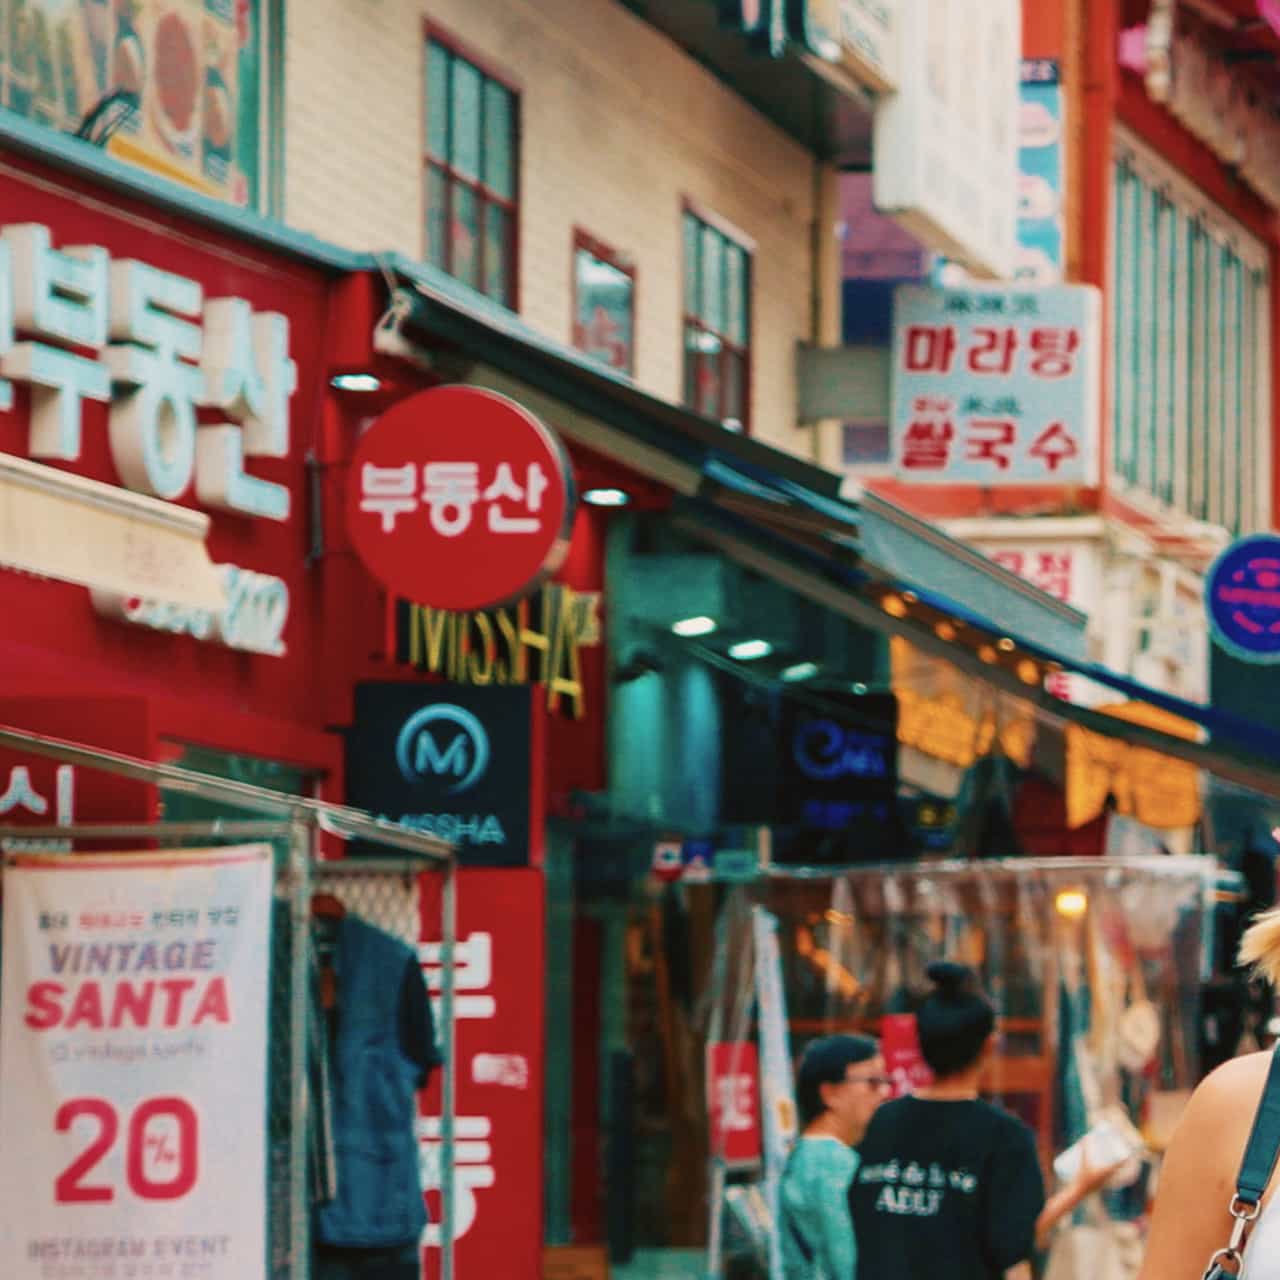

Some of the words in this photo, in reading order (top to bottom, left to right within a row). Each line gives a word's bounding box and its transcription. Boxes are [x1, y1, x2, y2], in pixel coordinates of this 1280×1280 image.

[0, 222, 297, 523] 부동산
[905, 324, 1080, 379] 마라탕
[902, 420, 1077, 470] 쌀국수
[360, 462, 549, 537] 부동산
[376, 812, 506, 845] ISSHA
[50, 939, 217, 974] VINTAGE
[24, 977, 231, 1032] SANTA
[54, 1095, 199, 1205] 20
[28, 1236, 146, 1259] INSTAGRAM
[154, 1234, 230, 1257] EVENT
